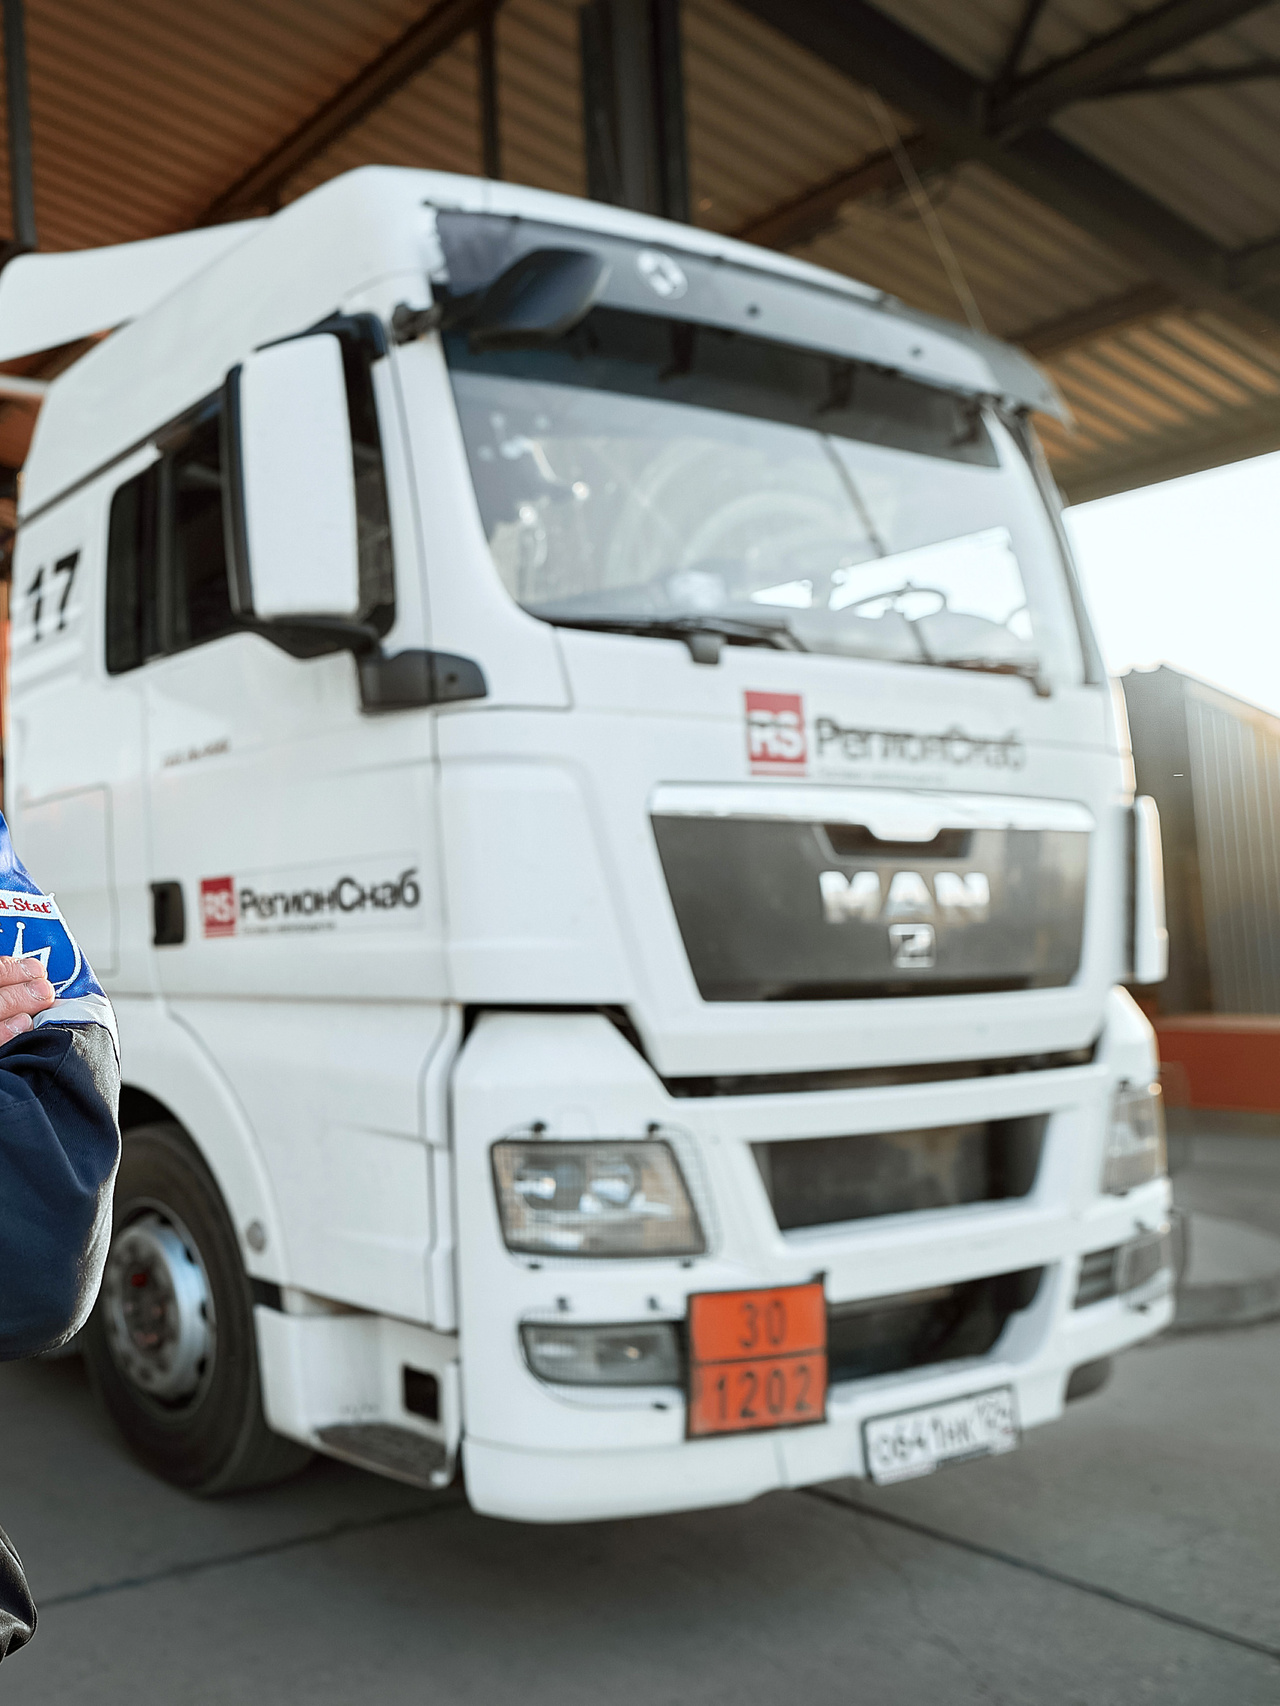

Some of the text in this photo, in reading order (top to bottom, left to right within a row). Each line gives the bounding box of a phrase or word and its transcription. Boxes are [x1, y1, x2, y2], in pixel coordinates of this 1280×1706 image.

[26, 547, 81, 643] 17
[239, 868, 420, 919] РегионСнаб
[819, 870, 991, 924] MAN
[739, 1301, 787, 1349] 30
[716, 1364, 811, 1419] 1202
